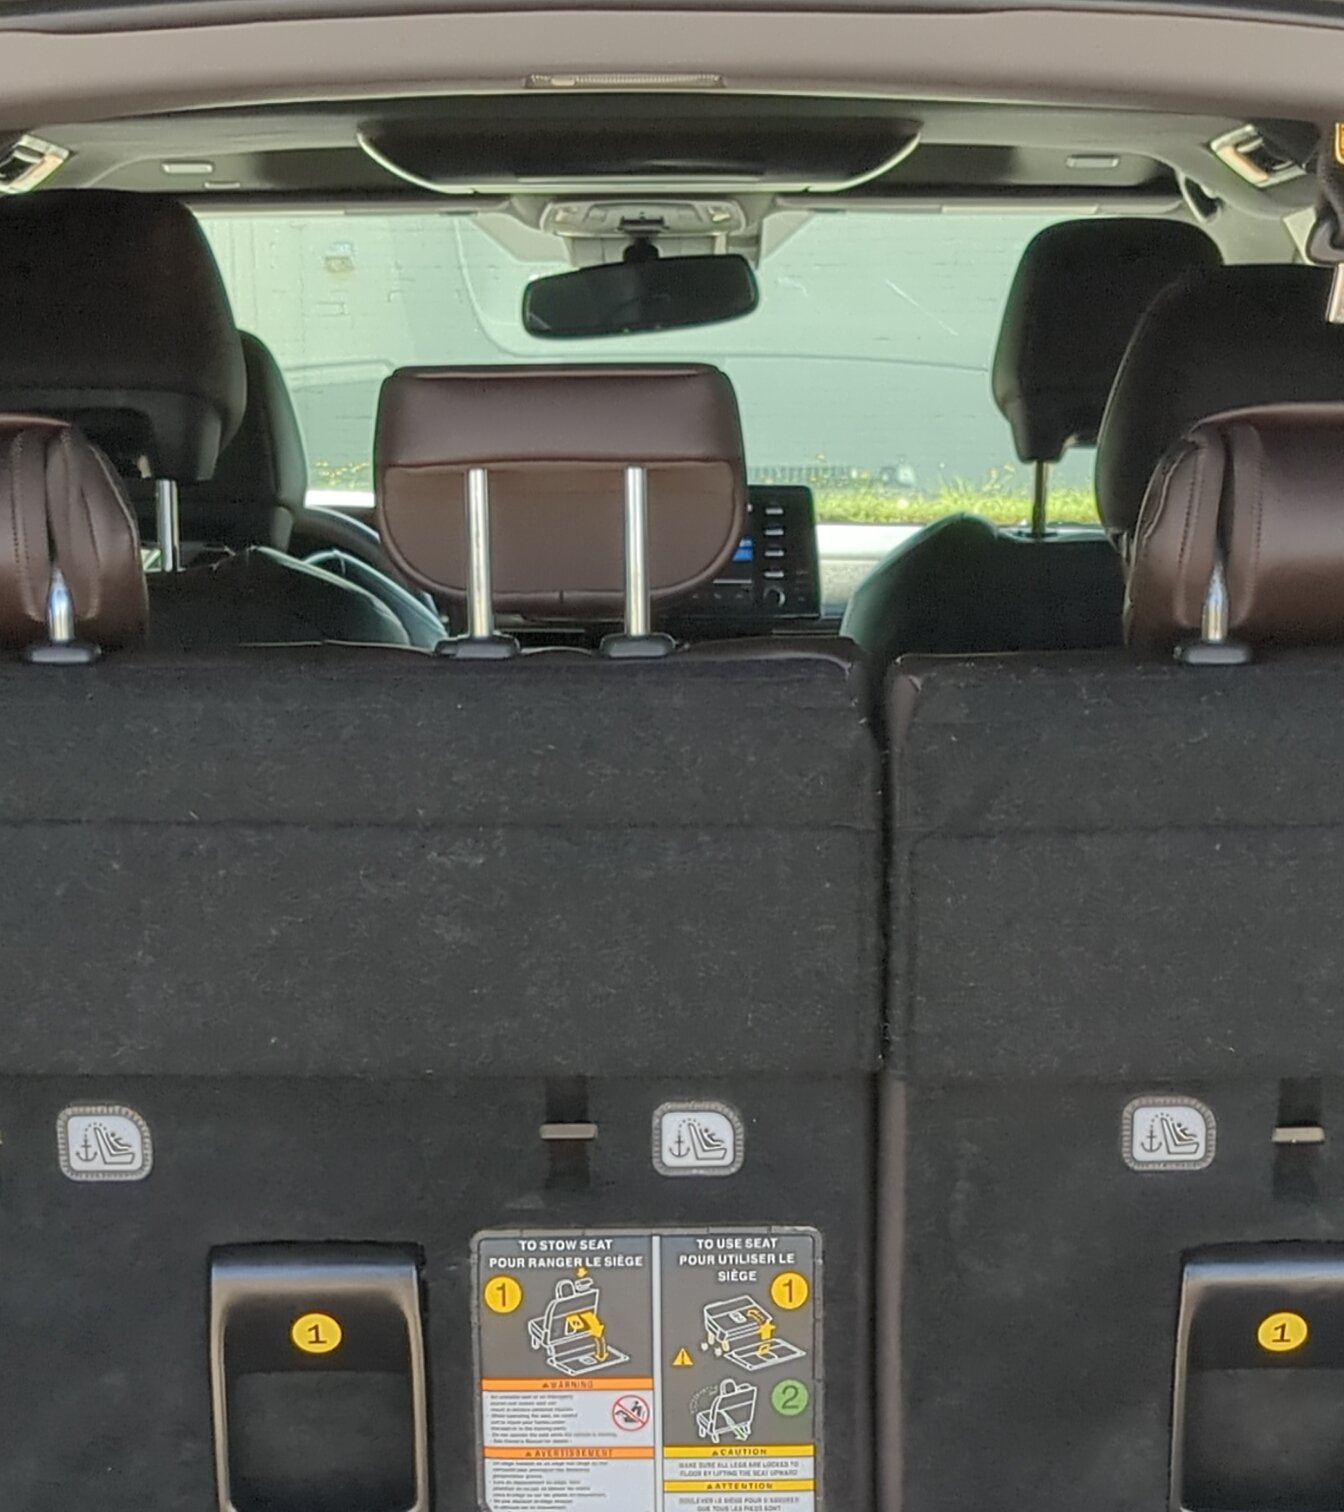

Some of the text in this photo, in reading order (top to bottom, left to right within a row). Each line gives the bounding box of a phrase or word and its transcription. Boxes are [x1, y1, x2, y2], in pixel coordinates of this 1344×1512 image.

[518, 1239, 613, 1251] TO STOW SEAT
[696, 1237, 778, 1250] TO USE SEAT
[489, 1254, 643, 1268] POUR RANGER LE SIÈGE
[679, 1252, 795, 1266] POUR UTILISER LE
[717, 1268, 757, 1282] SIÈGE
[496, 1282, 506, 1308] 1
[782, 1279, 794, 1304] 1
[307, 1323, 328, 1345] 1
[1271, 1322, 1292, 1344] 1
[550, 1380, 594, 1389] WARNING
[781, 1384, 800, 1409] 2
[720, 1448, 768, 1457] CAUTION
[715, 1482, 774, 1490] ATTENTION
